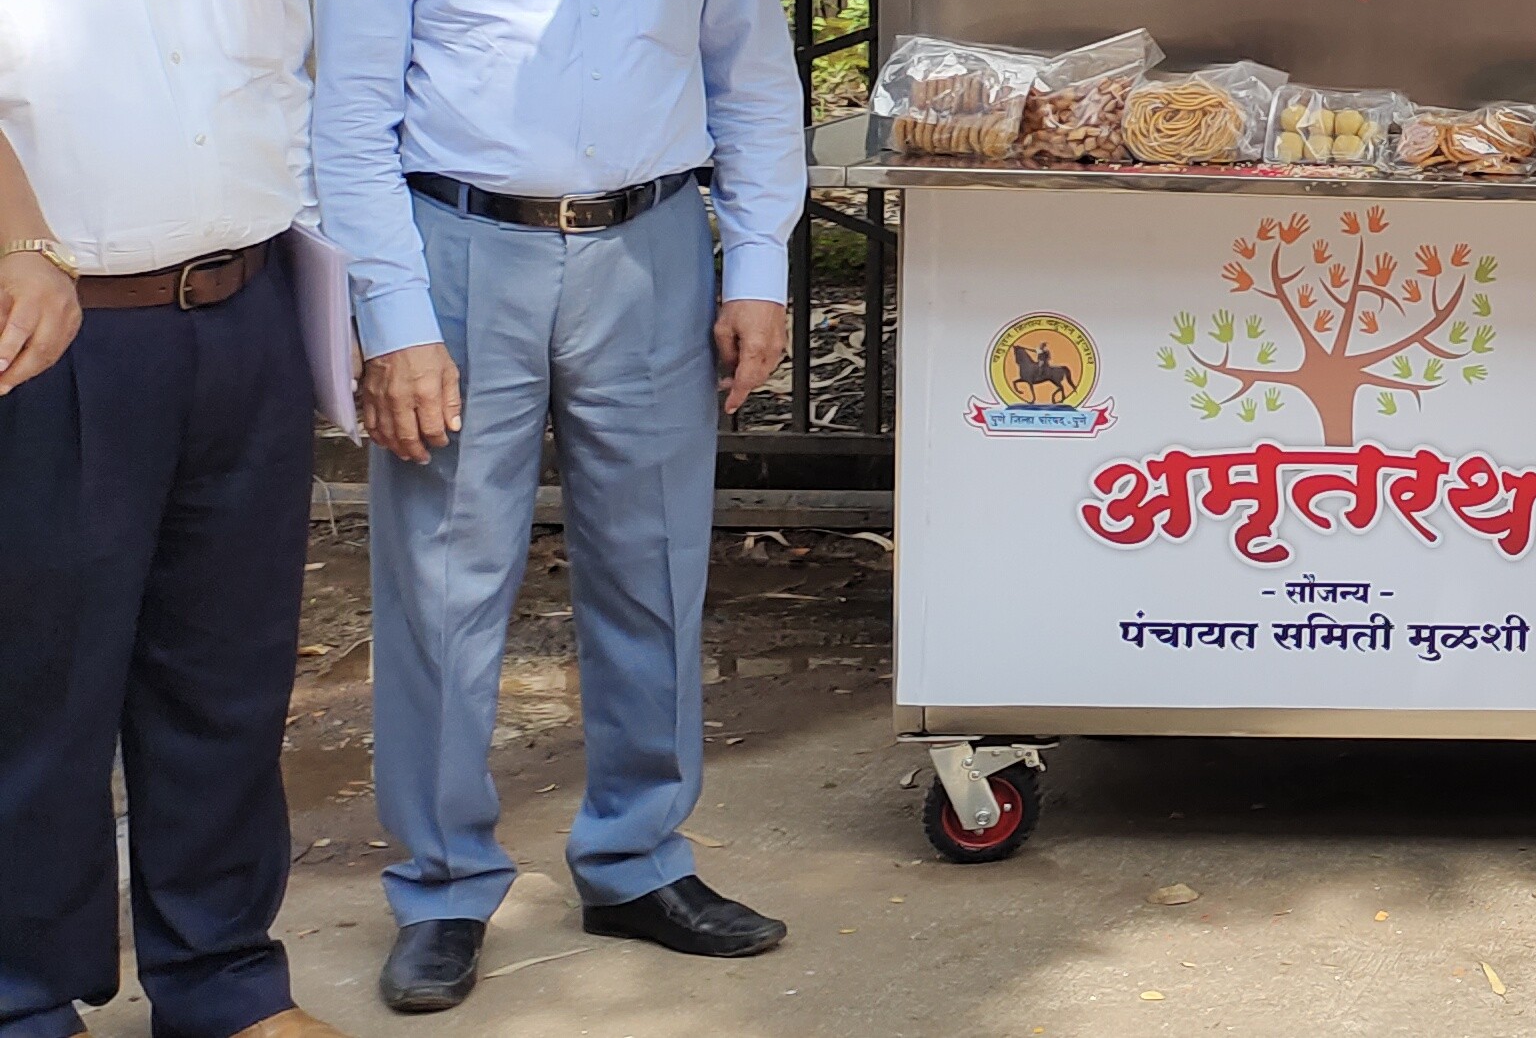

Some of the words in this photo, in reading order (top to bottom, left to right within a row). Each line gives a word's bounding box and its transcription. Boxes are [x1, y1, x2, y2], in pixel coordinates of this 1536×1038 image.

[1284, 573, 1372, 604] सौजन्य
[1118, 610, 1260, 651] पंचायत
[1271, 612, 1395, 652] समिती
[1406, 613, 1531, 662] मुळशी
